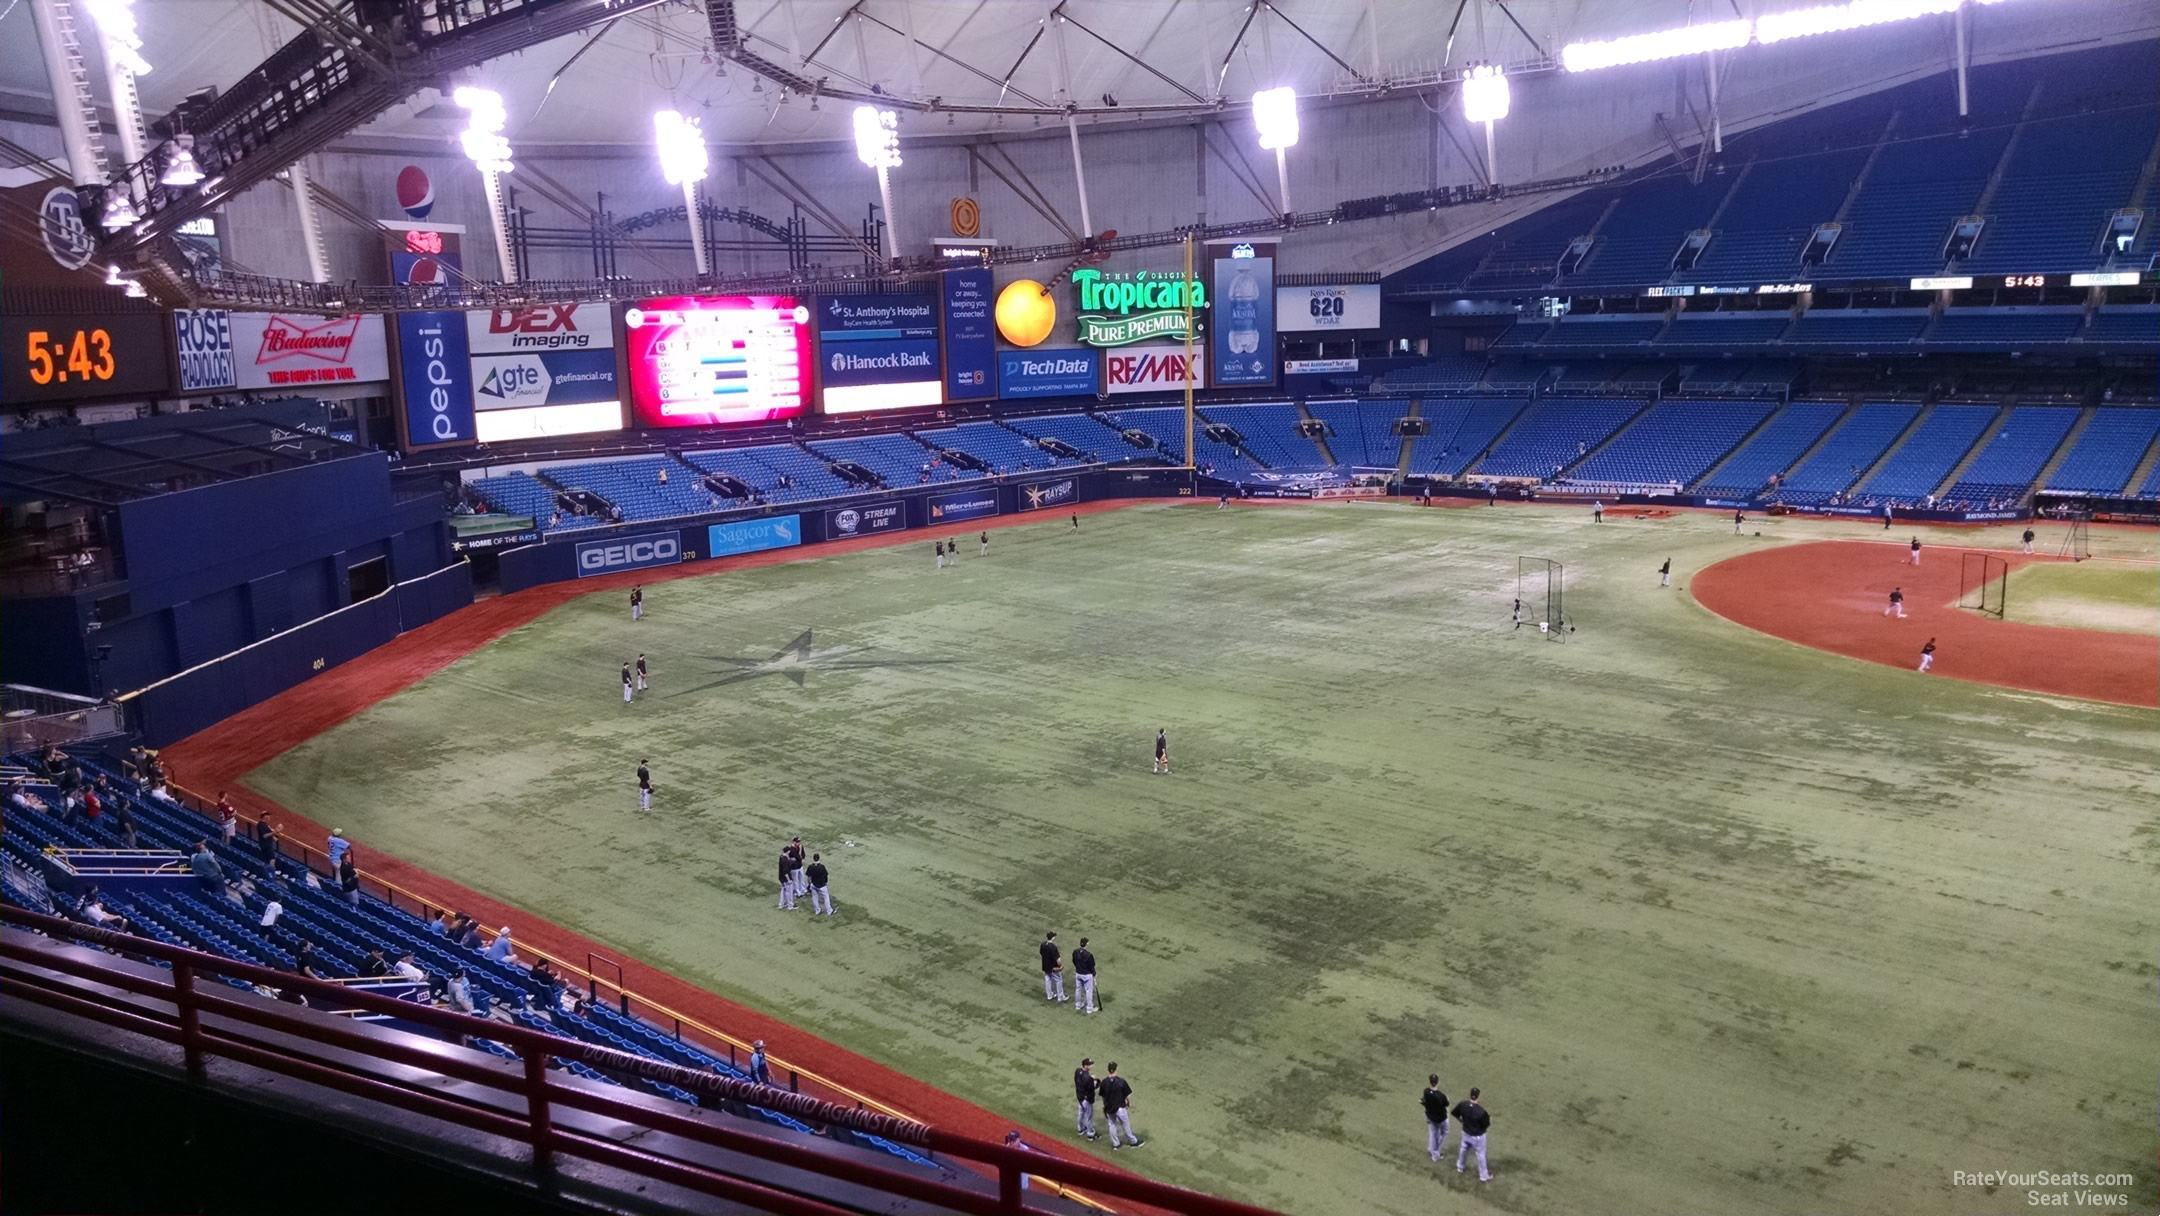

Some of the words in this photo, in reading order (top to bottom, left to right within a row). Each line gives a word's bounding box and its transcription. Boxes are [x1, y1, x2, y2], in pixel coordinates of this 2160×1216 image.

[1151, 271, 1199, 279] ORIGINL
[2005, 275, 2045, 287] 5:43
[959, 280, 976, 288] home
[1072, 269, 1204, 314] Tropicana
[1648, 287, 1664, 296] FLEX
[843, 307, 855, 318] St.
[856, 306, 895, 319] Anthony's
[897, 305, 930, 318] Hospital
[951, 300, 975, 309] keeping
[975, 301, 987, 309] you
[1310, 297, 1344, 317] 620
[489, 304, 580, 334] DEX
[953, 309, 986, 318] connected.
[176, 310, 231, 351] ROSE
[1089, 325, 1125, 341] PURE
[1128, 316, 1190, 338] PREMIUM
[263, 329, 352, 352] Budweiser
[512, 332, 589, 348] imaging
[28, 329, 116, 385] 5:43
[847, 352, 900, 369] Hancock
[901, 351, 930, 367] Bank
[180, 352, 233, 387] RADIOLOGY
[1108, 354, 1198, 385] RE/MAX
[419, 328, 458, 439] pepsi
[503, 364, 539, 392] gte
[555, 372, 613, 385] gtefinancial.org
[1178, 487, 1192, 495] 322
[945, 499, 995, 511] MicroLumen
[841, 513, 855, 521] FOX
[864, 507, 897, 519] STREAM
[872, 517, 889, 528] LIVE
[469, 539, 492, 548] HOME
[493, 537, 502, 545] OF
[504, 535, 518, 543] THE
[518, 533, 538, 542] RAYS
[719, 525, 770, 546] Sagicor
[581, 538, 677, 569] GEICO
[682, 550, 696, 561] 370
[313, 657, 325, 670] 404
[739, 1082, 764, 1100] OR
[763, 1087, 817, 1113] STAND
[819, 1101, 896, 1132] AGAINST
[895, 1118, 932, 1143] RAIL
